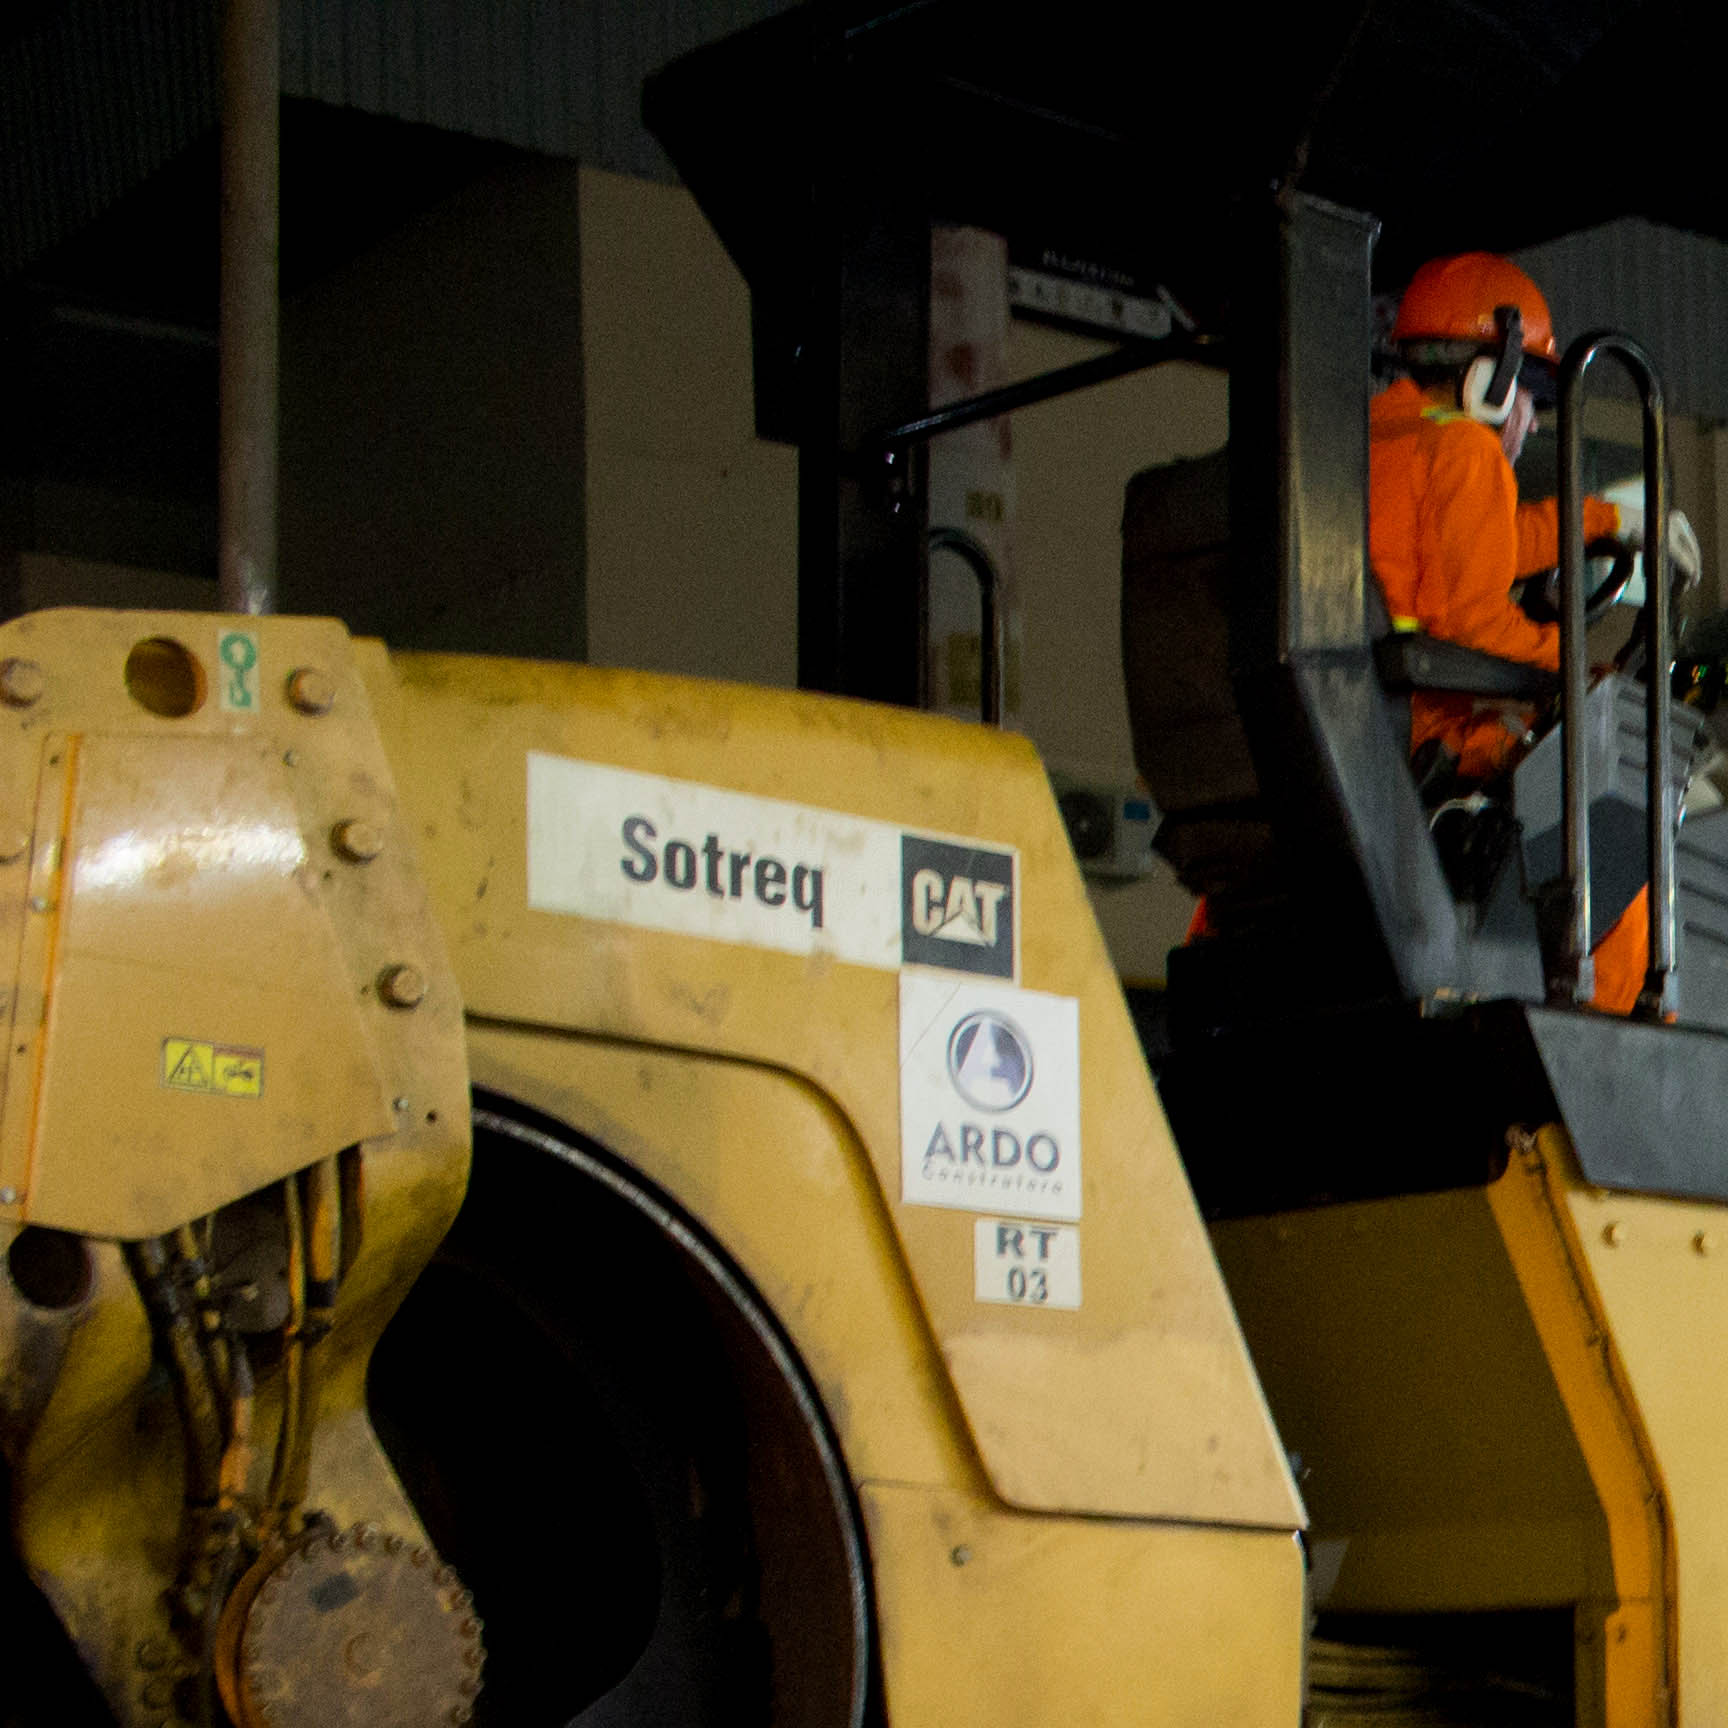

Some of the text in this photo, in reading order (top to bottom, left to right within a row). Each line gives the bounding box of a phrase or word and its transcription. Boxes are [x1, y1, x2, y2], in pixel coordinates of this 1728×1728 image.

[621, 816, 1009, 947] Sotreq CAT
[924, 1121, 1061, 1173] ARDO
[996, 1226, 1059, 1259] RT
[1007, 1267, 1050, 1305] 03
